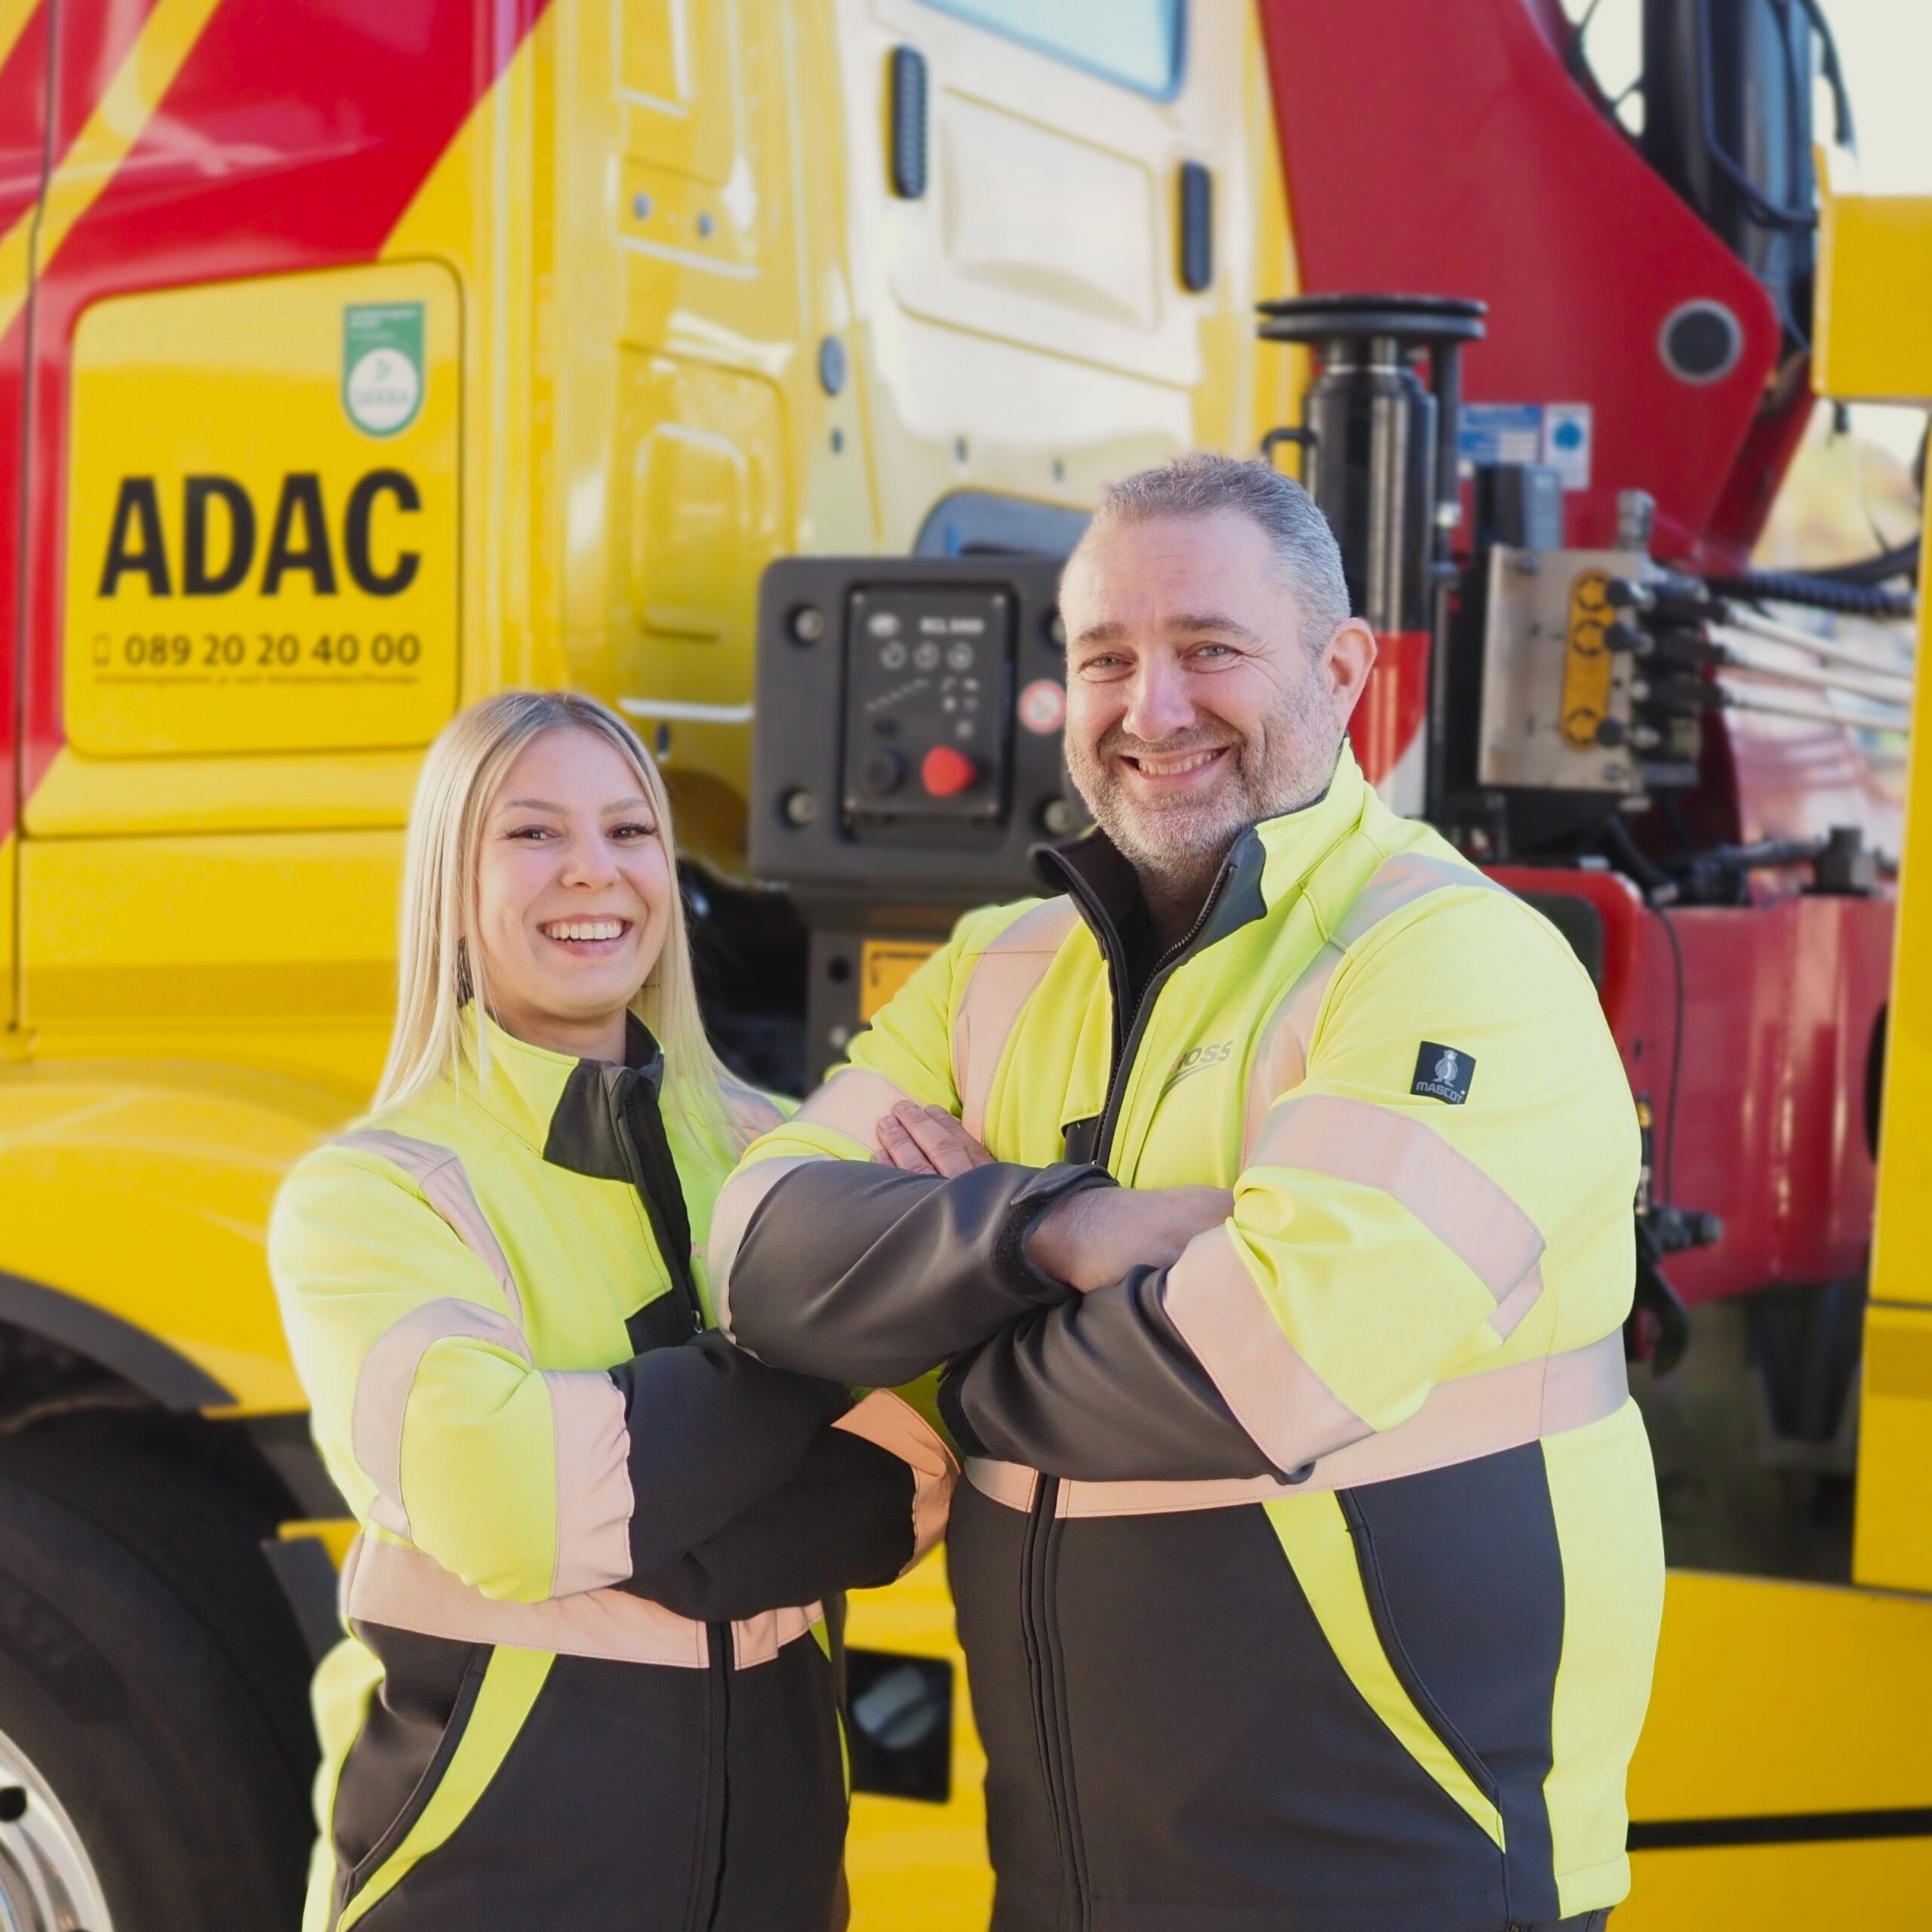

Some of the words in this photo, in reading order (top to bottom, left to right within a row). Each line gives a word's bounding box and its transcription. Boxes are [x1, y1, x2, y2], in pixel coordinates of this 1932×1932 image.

[98, 466, 422, 598] ADAC
[124, 633, 192, 667] 089
[202, 633, 246, 666] 20
[256, 633, 300, 666] 20
[311, 633, 360, 666] 40
[371, 632, 422, 666] 00
[1416, 1081, 1463, 1104] MASCOT
